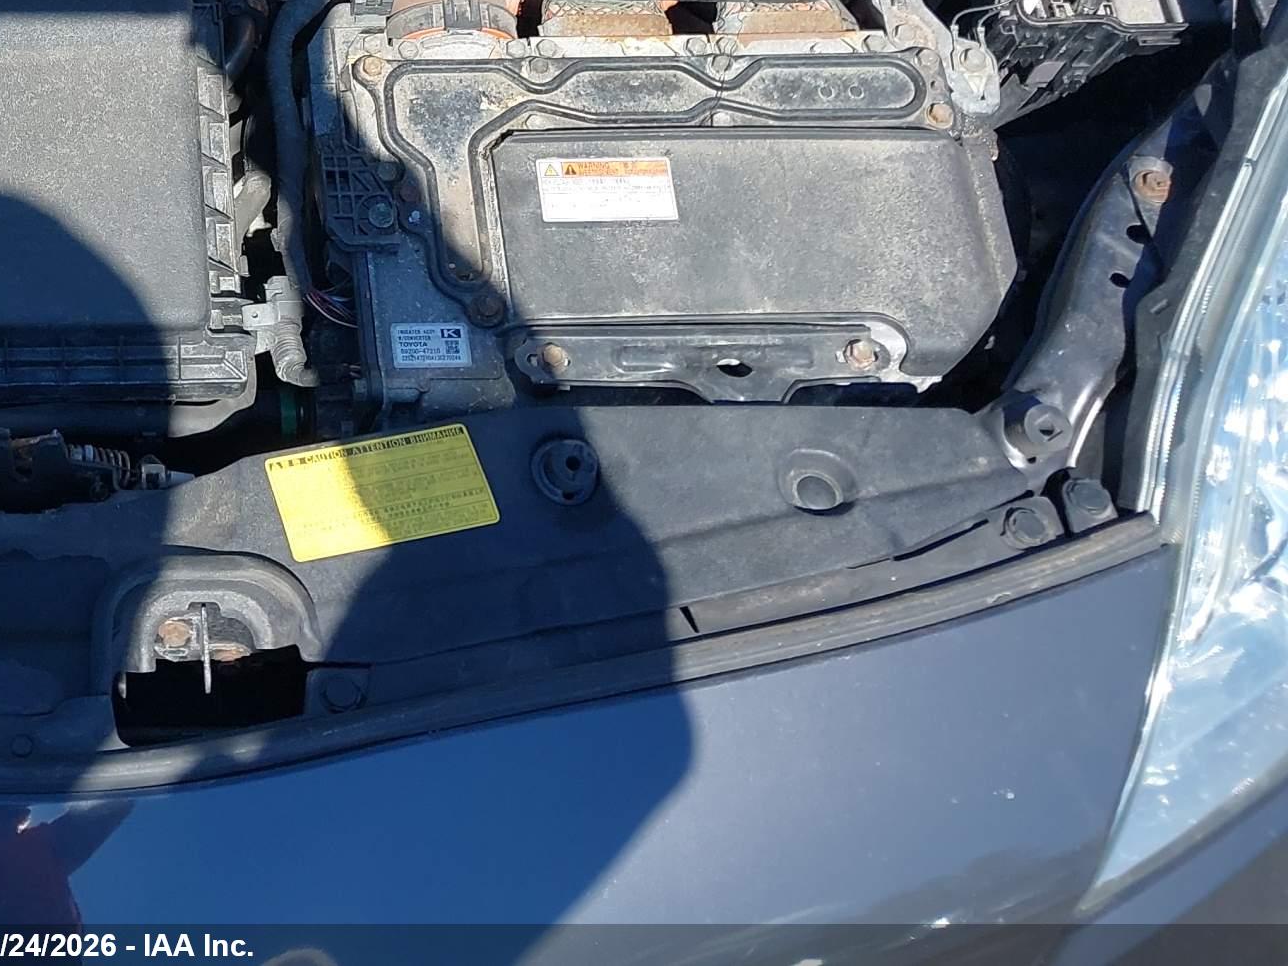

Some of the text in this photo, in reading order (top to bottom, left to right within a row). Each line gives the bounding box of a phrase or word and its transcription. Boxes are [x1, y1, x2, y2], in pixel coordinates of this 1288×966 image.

[443, 329, 459, 338] K
[305, 437, 407, 465] CAUTION ATTENTION
